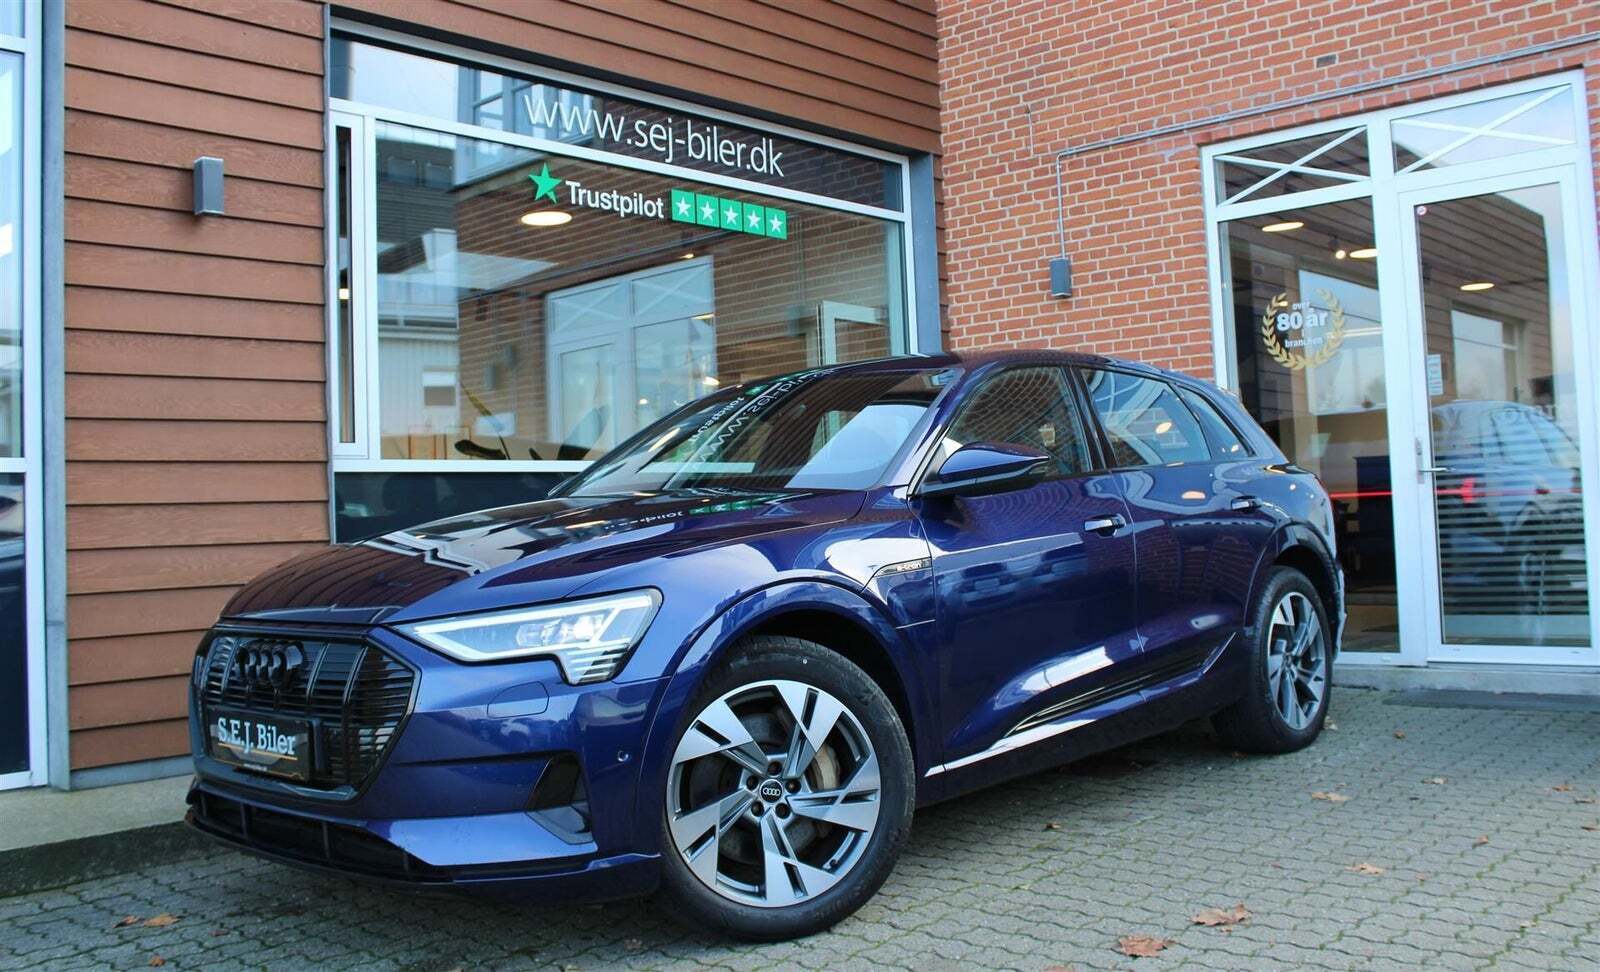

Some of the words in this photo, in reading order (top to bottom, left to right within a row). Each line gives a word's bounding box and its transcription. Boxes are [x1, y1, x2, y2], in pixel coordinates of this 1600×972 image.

[523, 94, 785, 178] www.sej-biler.dk
[565, 180, 665, 219] Trustpilot
[1276, 311, 1303, 332] 80
[1305, 307, 1329, 328] år
[217, 717, 254, 754] S.E.J.
[256, 723, 297, 756] Biler
